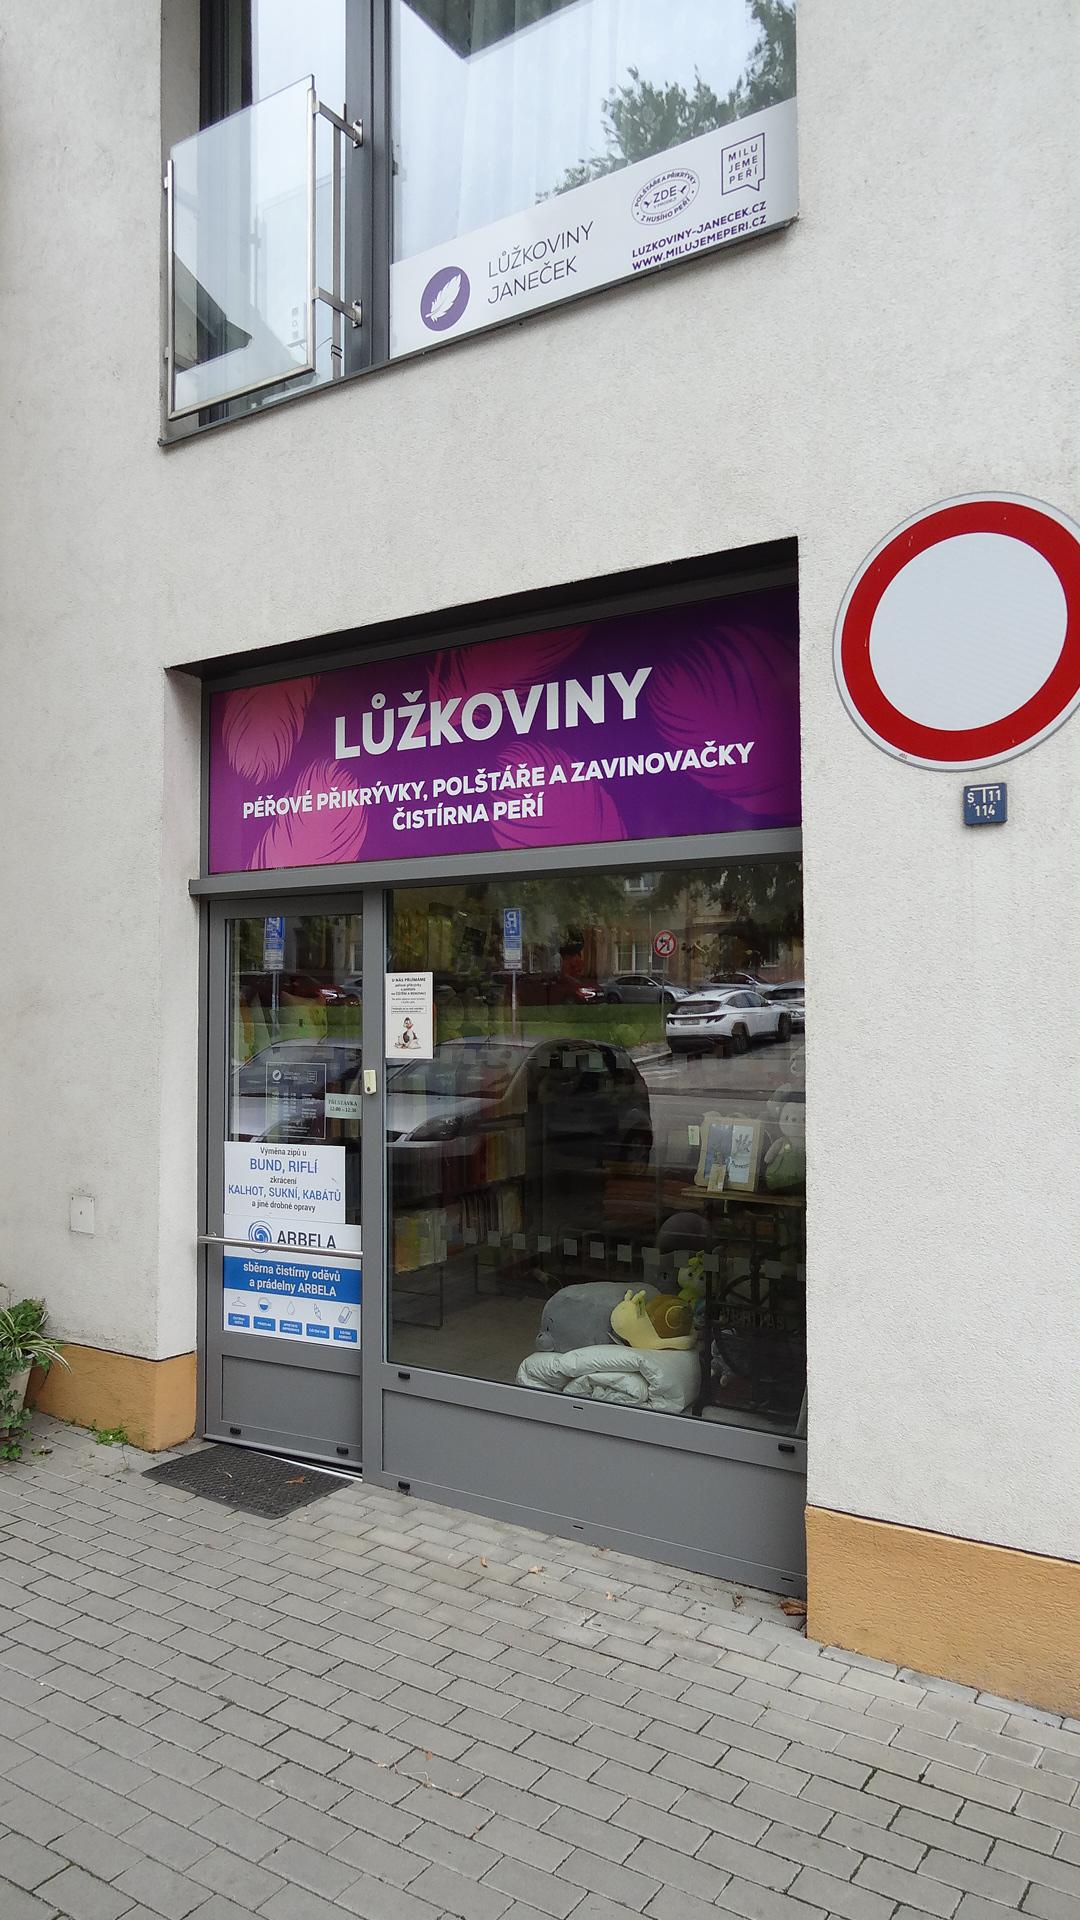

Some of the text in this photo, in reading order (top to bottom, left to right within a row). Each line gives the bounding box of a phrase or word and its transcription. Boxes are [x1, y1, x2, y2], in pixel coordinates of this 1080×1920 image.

[728, 144, 758, 162] MILU
[728, 155, 758, 173] JEME
[729, 165, 758, 184] PEŘÍ
[653, 185, 677, 204] ZDE
[646, 210, 673, 222] HUSÍHO
[632, 200, 767, 258] LUZKOVINY-JANECEK.CZ
[488, 220, 594, 278] LŮŽKOVINY
[632, 215, 767, 270] WWW.MILUJEMEPERI.CZ
[488, 256, 577, 304] JANEČEK
[335, 666, 654, 760] LŮŽKOVINY
[243, 741, 755, 819] PÉŘOVÉ PŘIKRÝVKY, POLŠTÁŘE A ZAVINOVAČKY
[392, 792, 544, 831] ČISTÍRNA PEŘÍ
[260, 1147, 285, 1156] Výměna
[288, 1148, 300, 1157] zipů
[250, 1158, 318, 1174] BUND, RIFLÍ
[270, 1176, 296, 1184] zkrácení
[228, 1184, 341, 1202] KALHOT, SUKNÍ, KABÁTŮ
[257, 1200, 268, 1208] jiné
[270, 1201, 292, 1209] drobné
[294, 1204, 316, 1213] opravy
[277, 1230, 336, 1248] ARBELA
[244, 1261, 340, 1282] sběrna čistírny oděvů
[257, 1278, 295, 1294] prádelny
[298, 1282, 336, 1296] ARBELA
